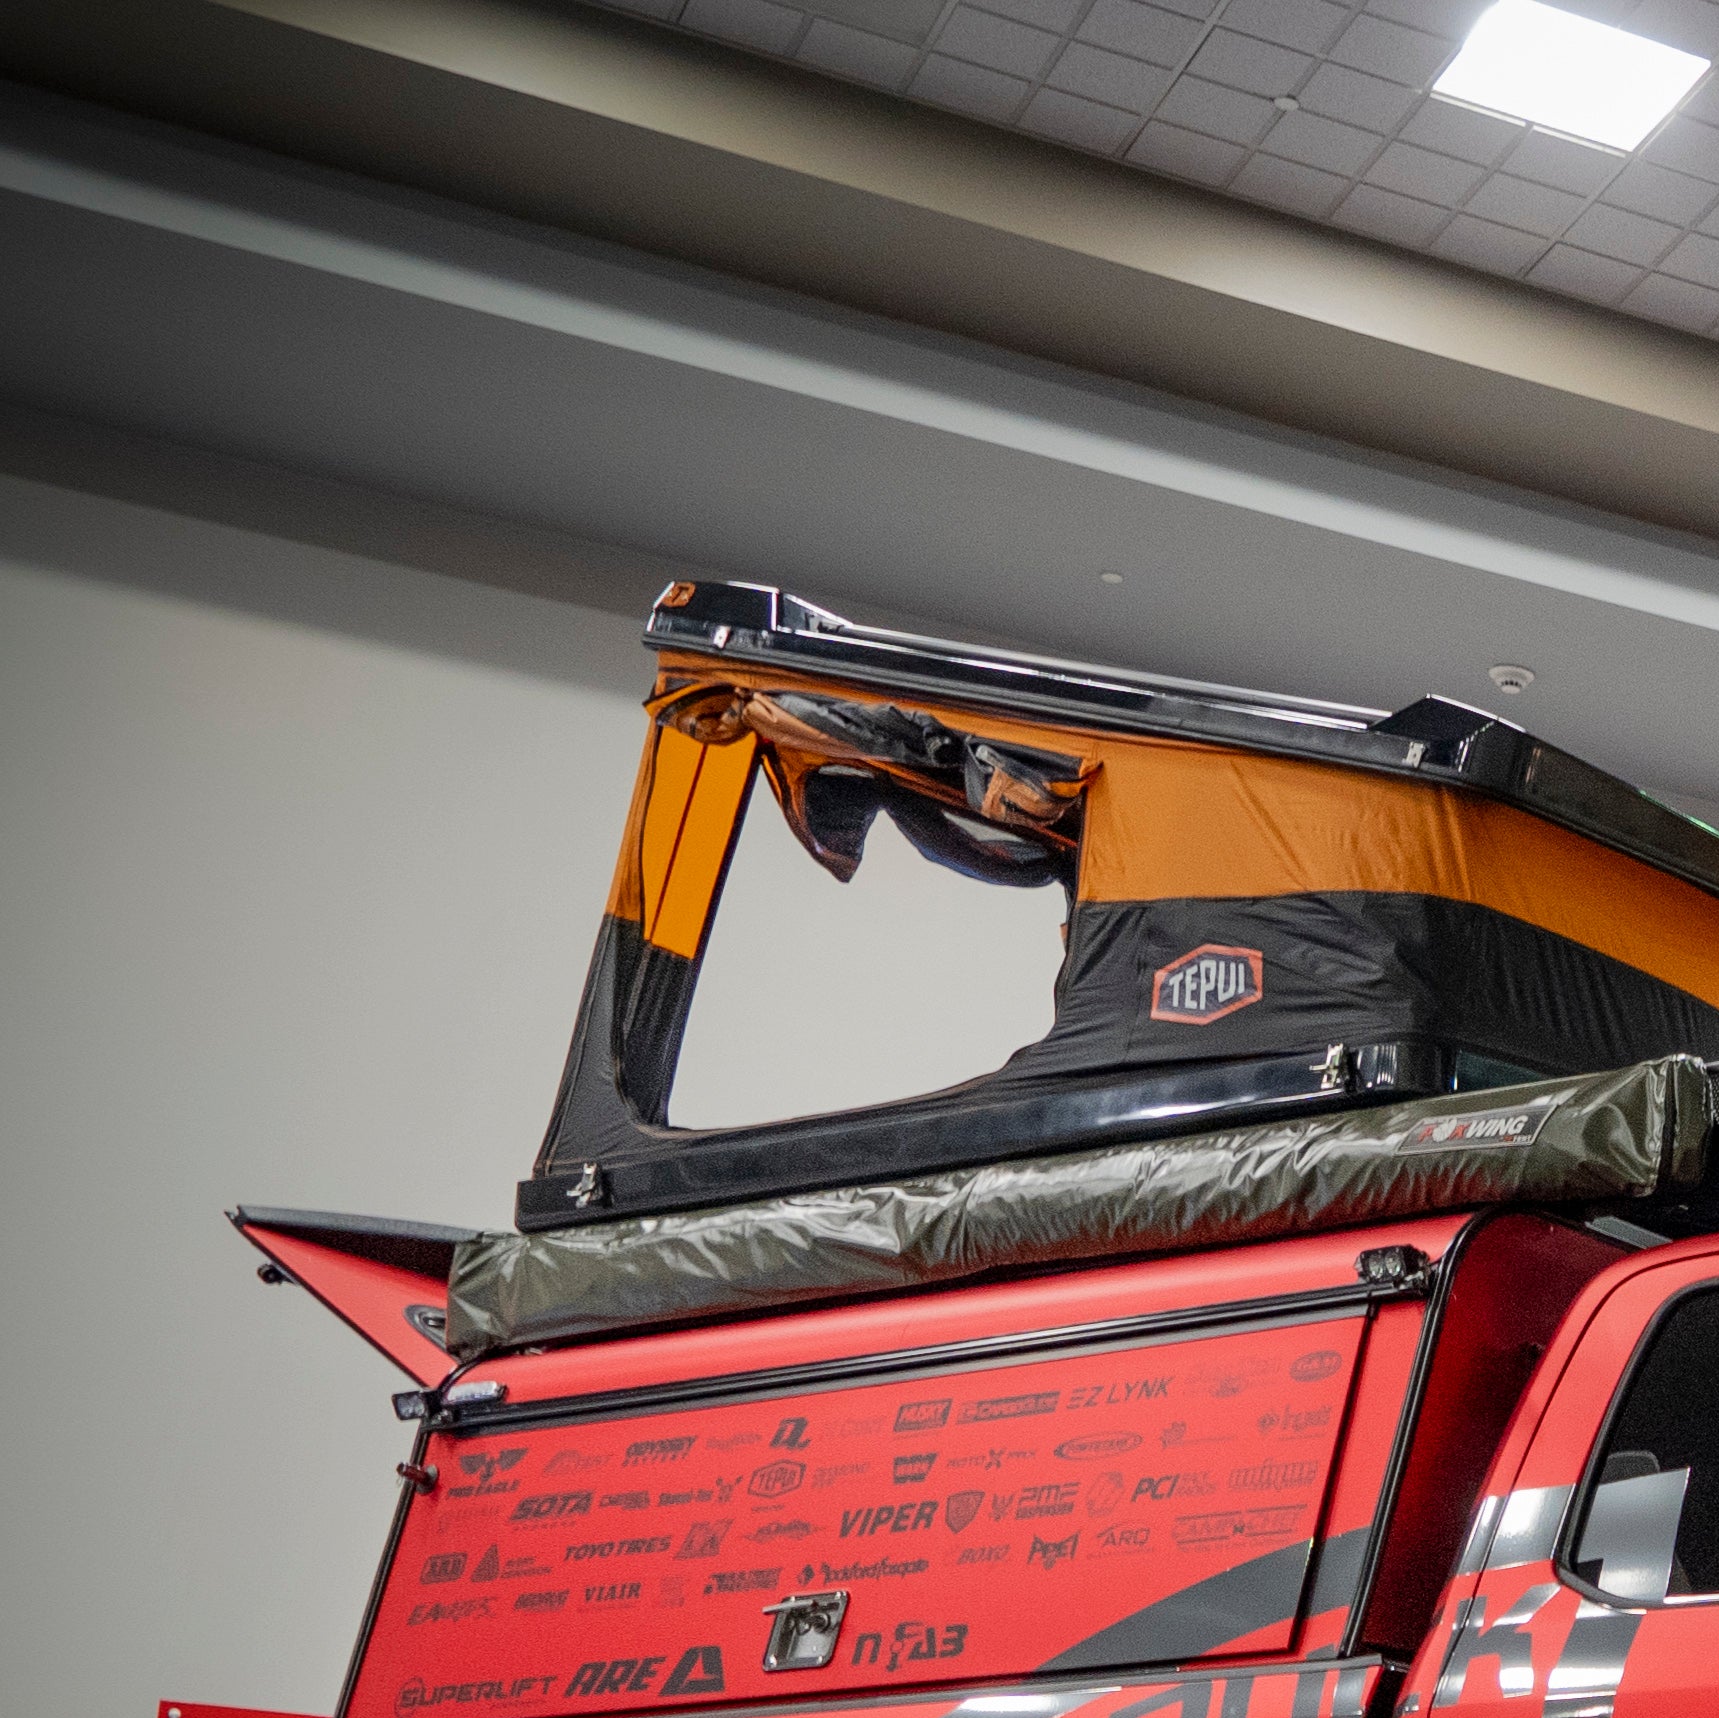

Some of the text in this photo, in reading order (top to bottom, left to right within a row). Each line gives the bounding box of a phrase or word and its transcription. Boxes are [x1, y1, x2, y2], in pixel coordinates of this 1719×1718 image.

[1168, 959, 1246, 1011] TEPUI
[1105, 1376, 1175, 1404] LYNK
[1130, 1473, 1181, 1503] PCI
[510, 1491, 594, 1522] SOTA
[839, 1501, 939, 1538] VIPER
[563, 1541, 616, 1562] TOYO
[584, 1582, 642, 1603] VIAIR
[400, 1676, 558, 1708] SUPERLIFT
[563, 1656, 668, 1698] ARE
